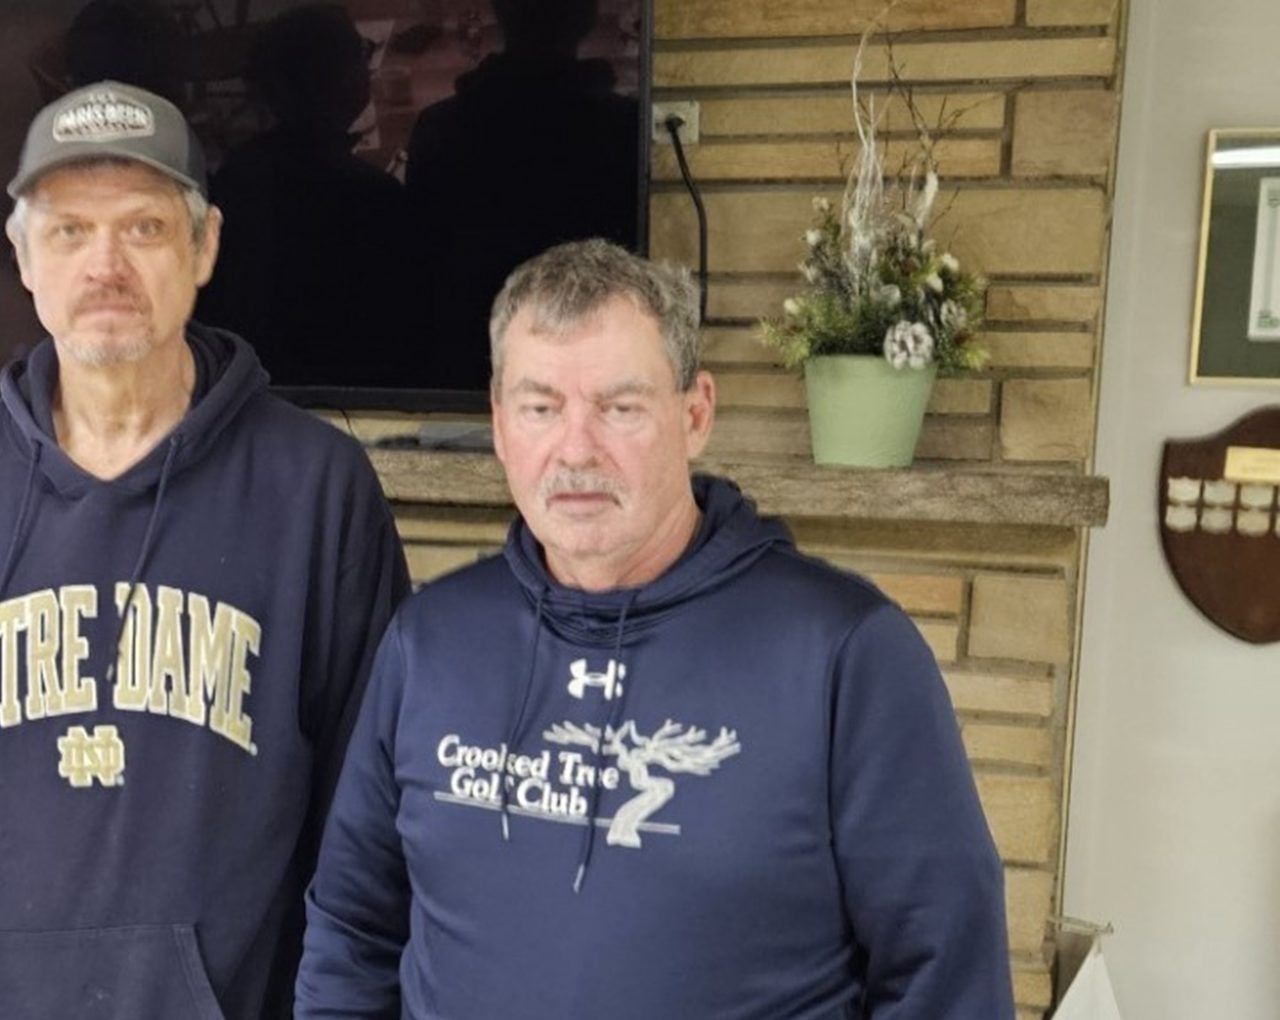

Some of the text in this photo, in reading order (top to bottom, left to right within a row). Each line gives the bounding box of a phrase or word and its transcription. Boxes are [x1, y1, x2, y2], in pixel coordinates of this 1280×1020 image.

[114, 581, 261, 753] DAME
[438, 734, 550, 779] Crooked
[517, 780, 588, 815] Club
